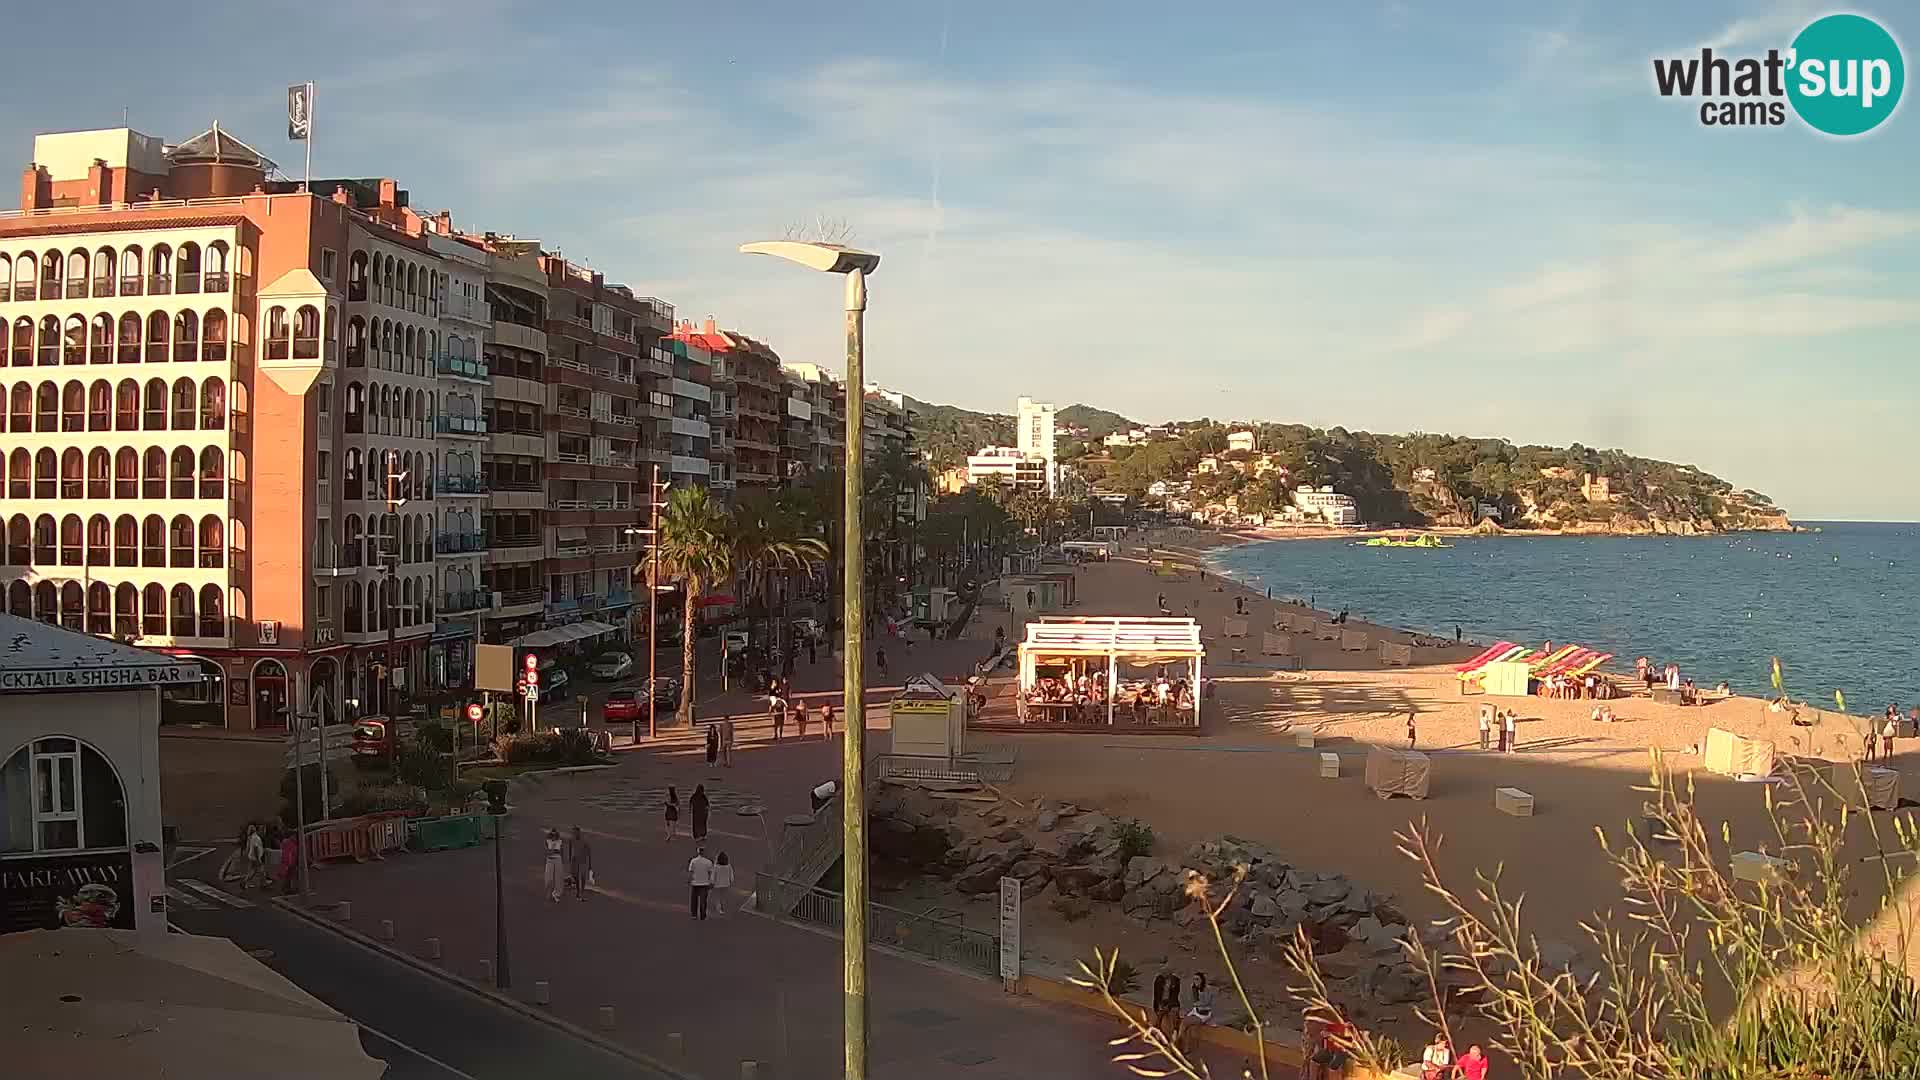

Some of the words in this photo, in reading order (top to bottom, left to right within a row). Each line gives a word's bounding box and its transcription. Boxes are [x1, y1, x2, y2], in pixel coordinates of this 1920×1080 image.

[66, 671, 77, 684] &
[81, 669, 143, 686] SHISHA
[148, 667, 180, 682] BAR
